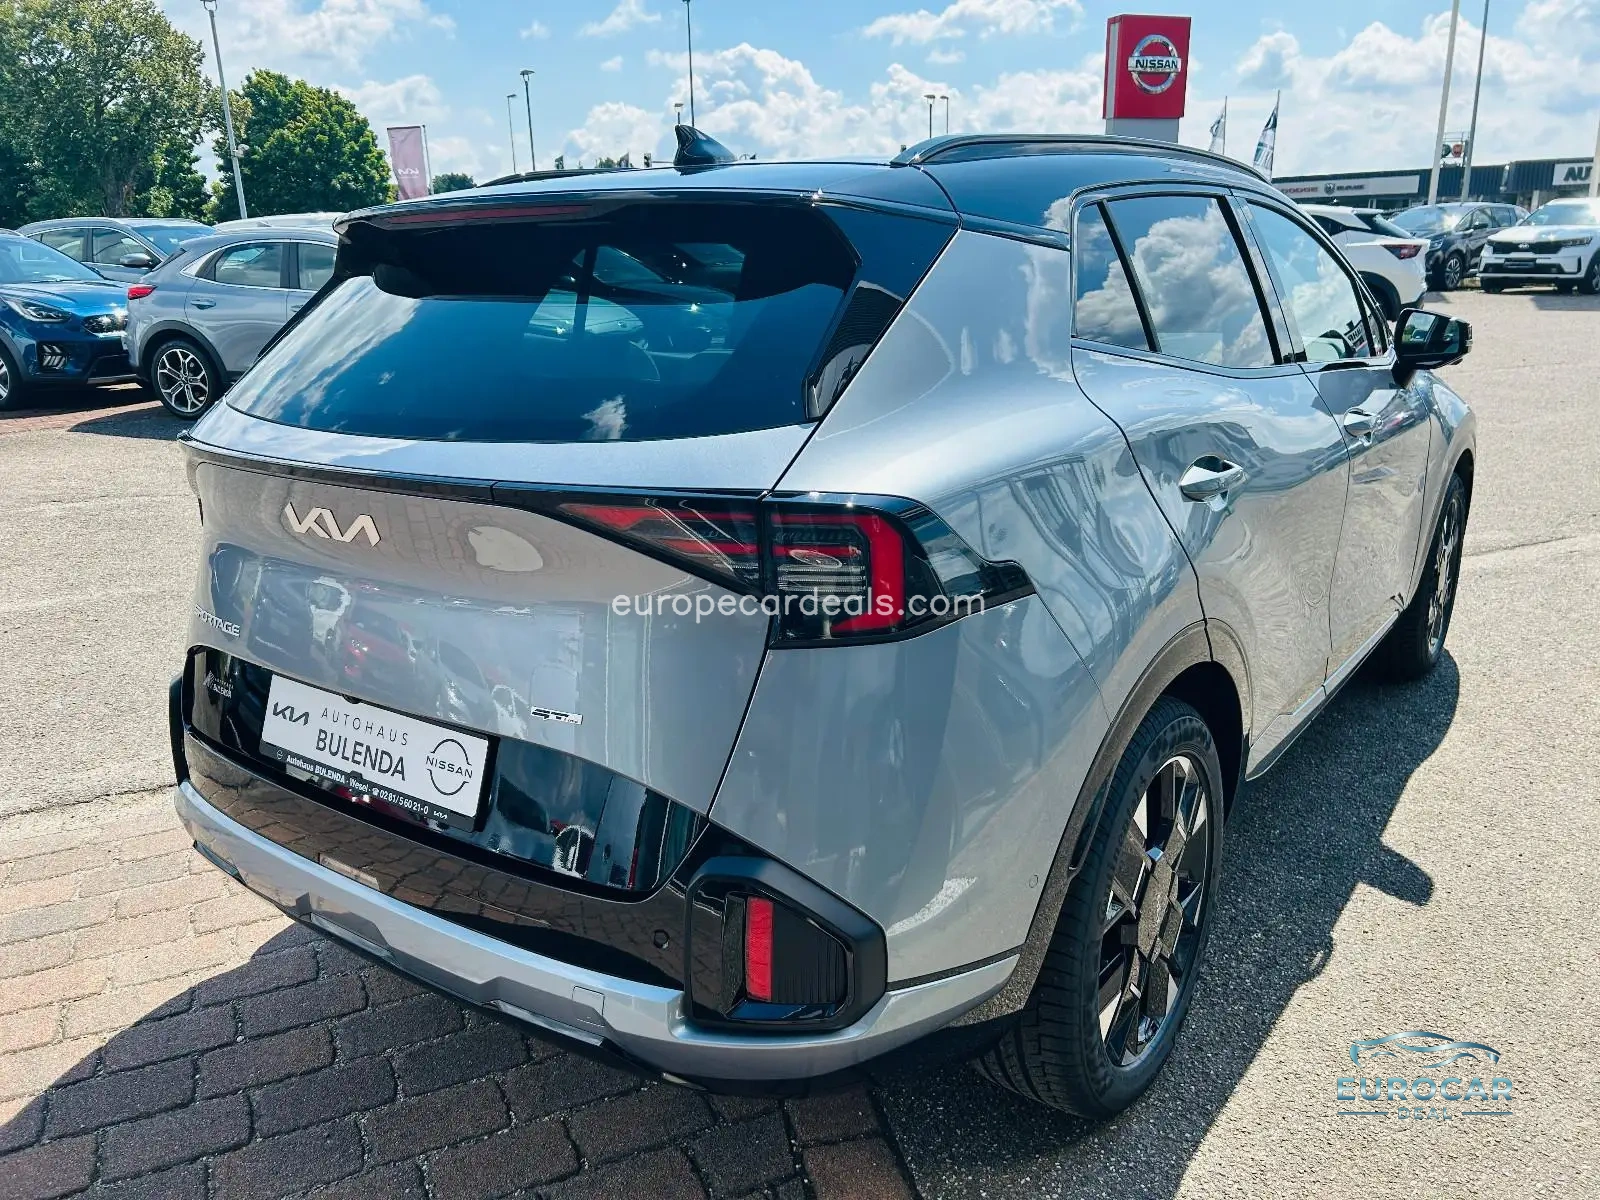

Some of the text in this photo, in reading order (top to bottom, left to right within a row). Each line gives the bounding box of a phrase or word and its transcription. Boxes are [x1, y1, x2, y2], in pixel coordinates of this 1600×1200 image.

[1135, 59, 1178, 69] NISSAN
[284, 501, 382, 547] KIA
[272, 702, 310, 726] KIA
[321, 707, 408, 746] AUTOHAUS
[286, 754, 314, 772] Autohaus
[314, 764, 346, 784] BULENDA
[349, 777, 369, 792] Wesel
[316, 728, 405, 781] BULENDA
[425, 755, 473, 779] NISSAN
